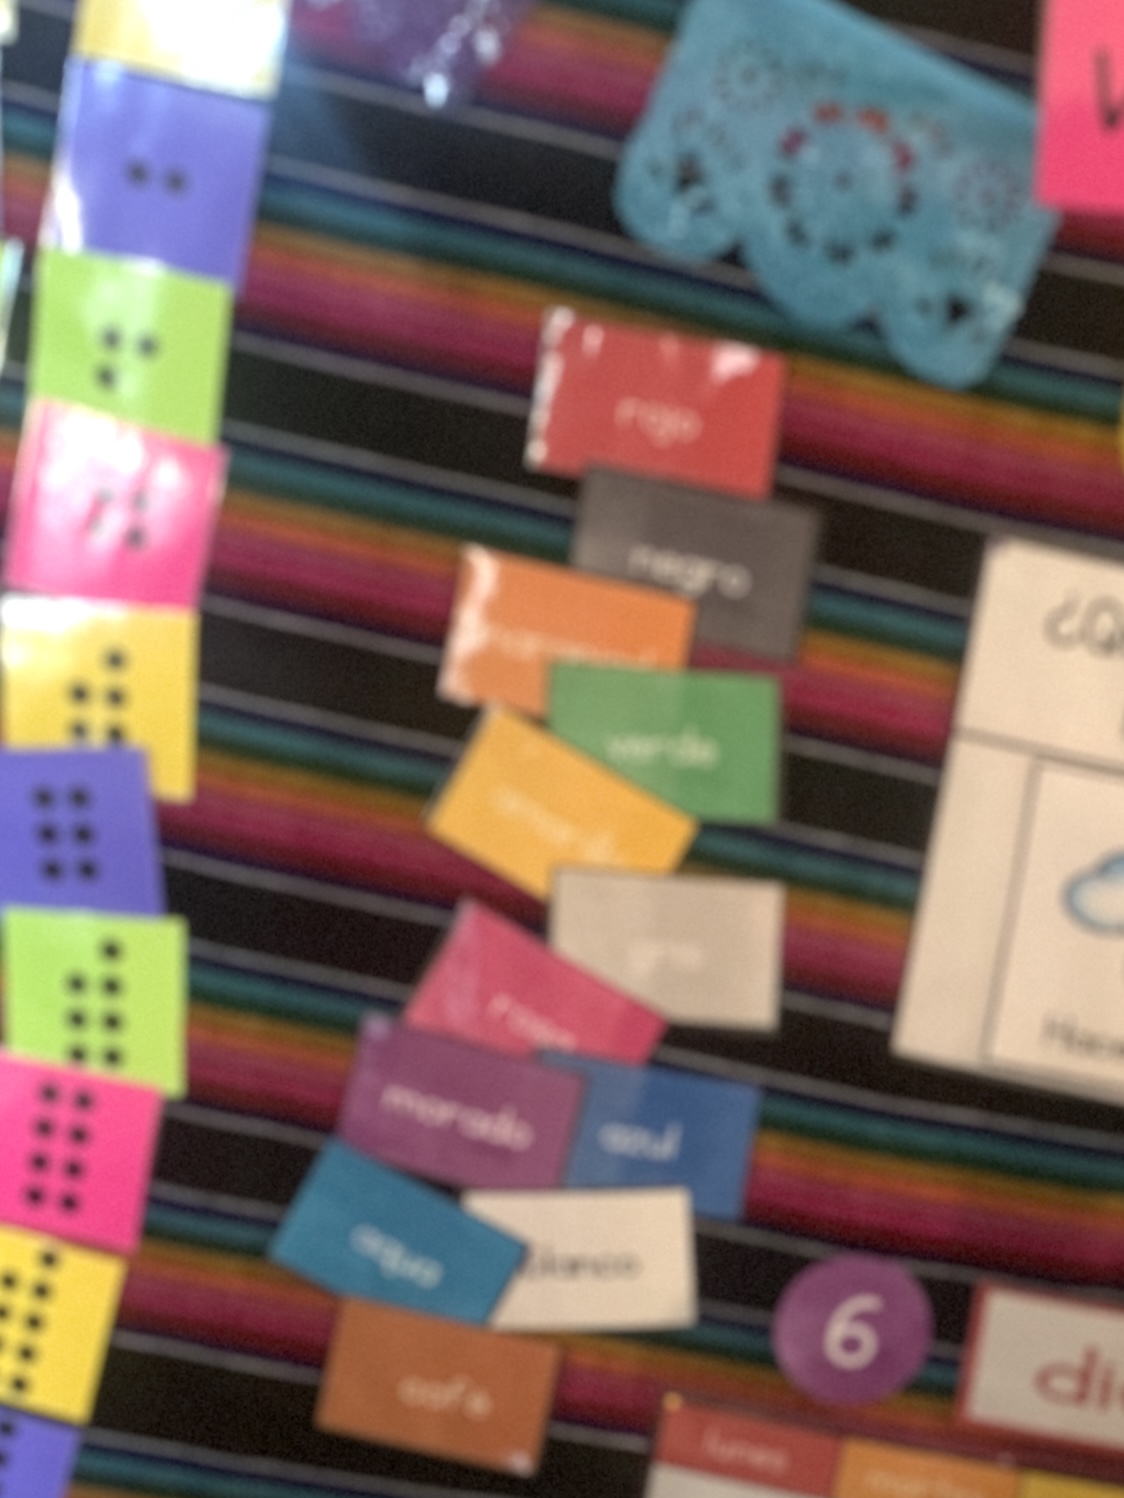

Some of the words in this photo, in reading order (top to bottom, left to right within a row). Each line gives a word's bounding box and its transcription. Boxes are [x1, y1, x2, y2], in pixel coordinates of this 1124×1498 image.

[628, 543, 754, 602] negro
[378, 1082, 534, 1153] morado
[597, 1118, 684, 1163] azul
[824, 1293, 884, 1370] 6
[702, 1432, 790, 1476] lunes
